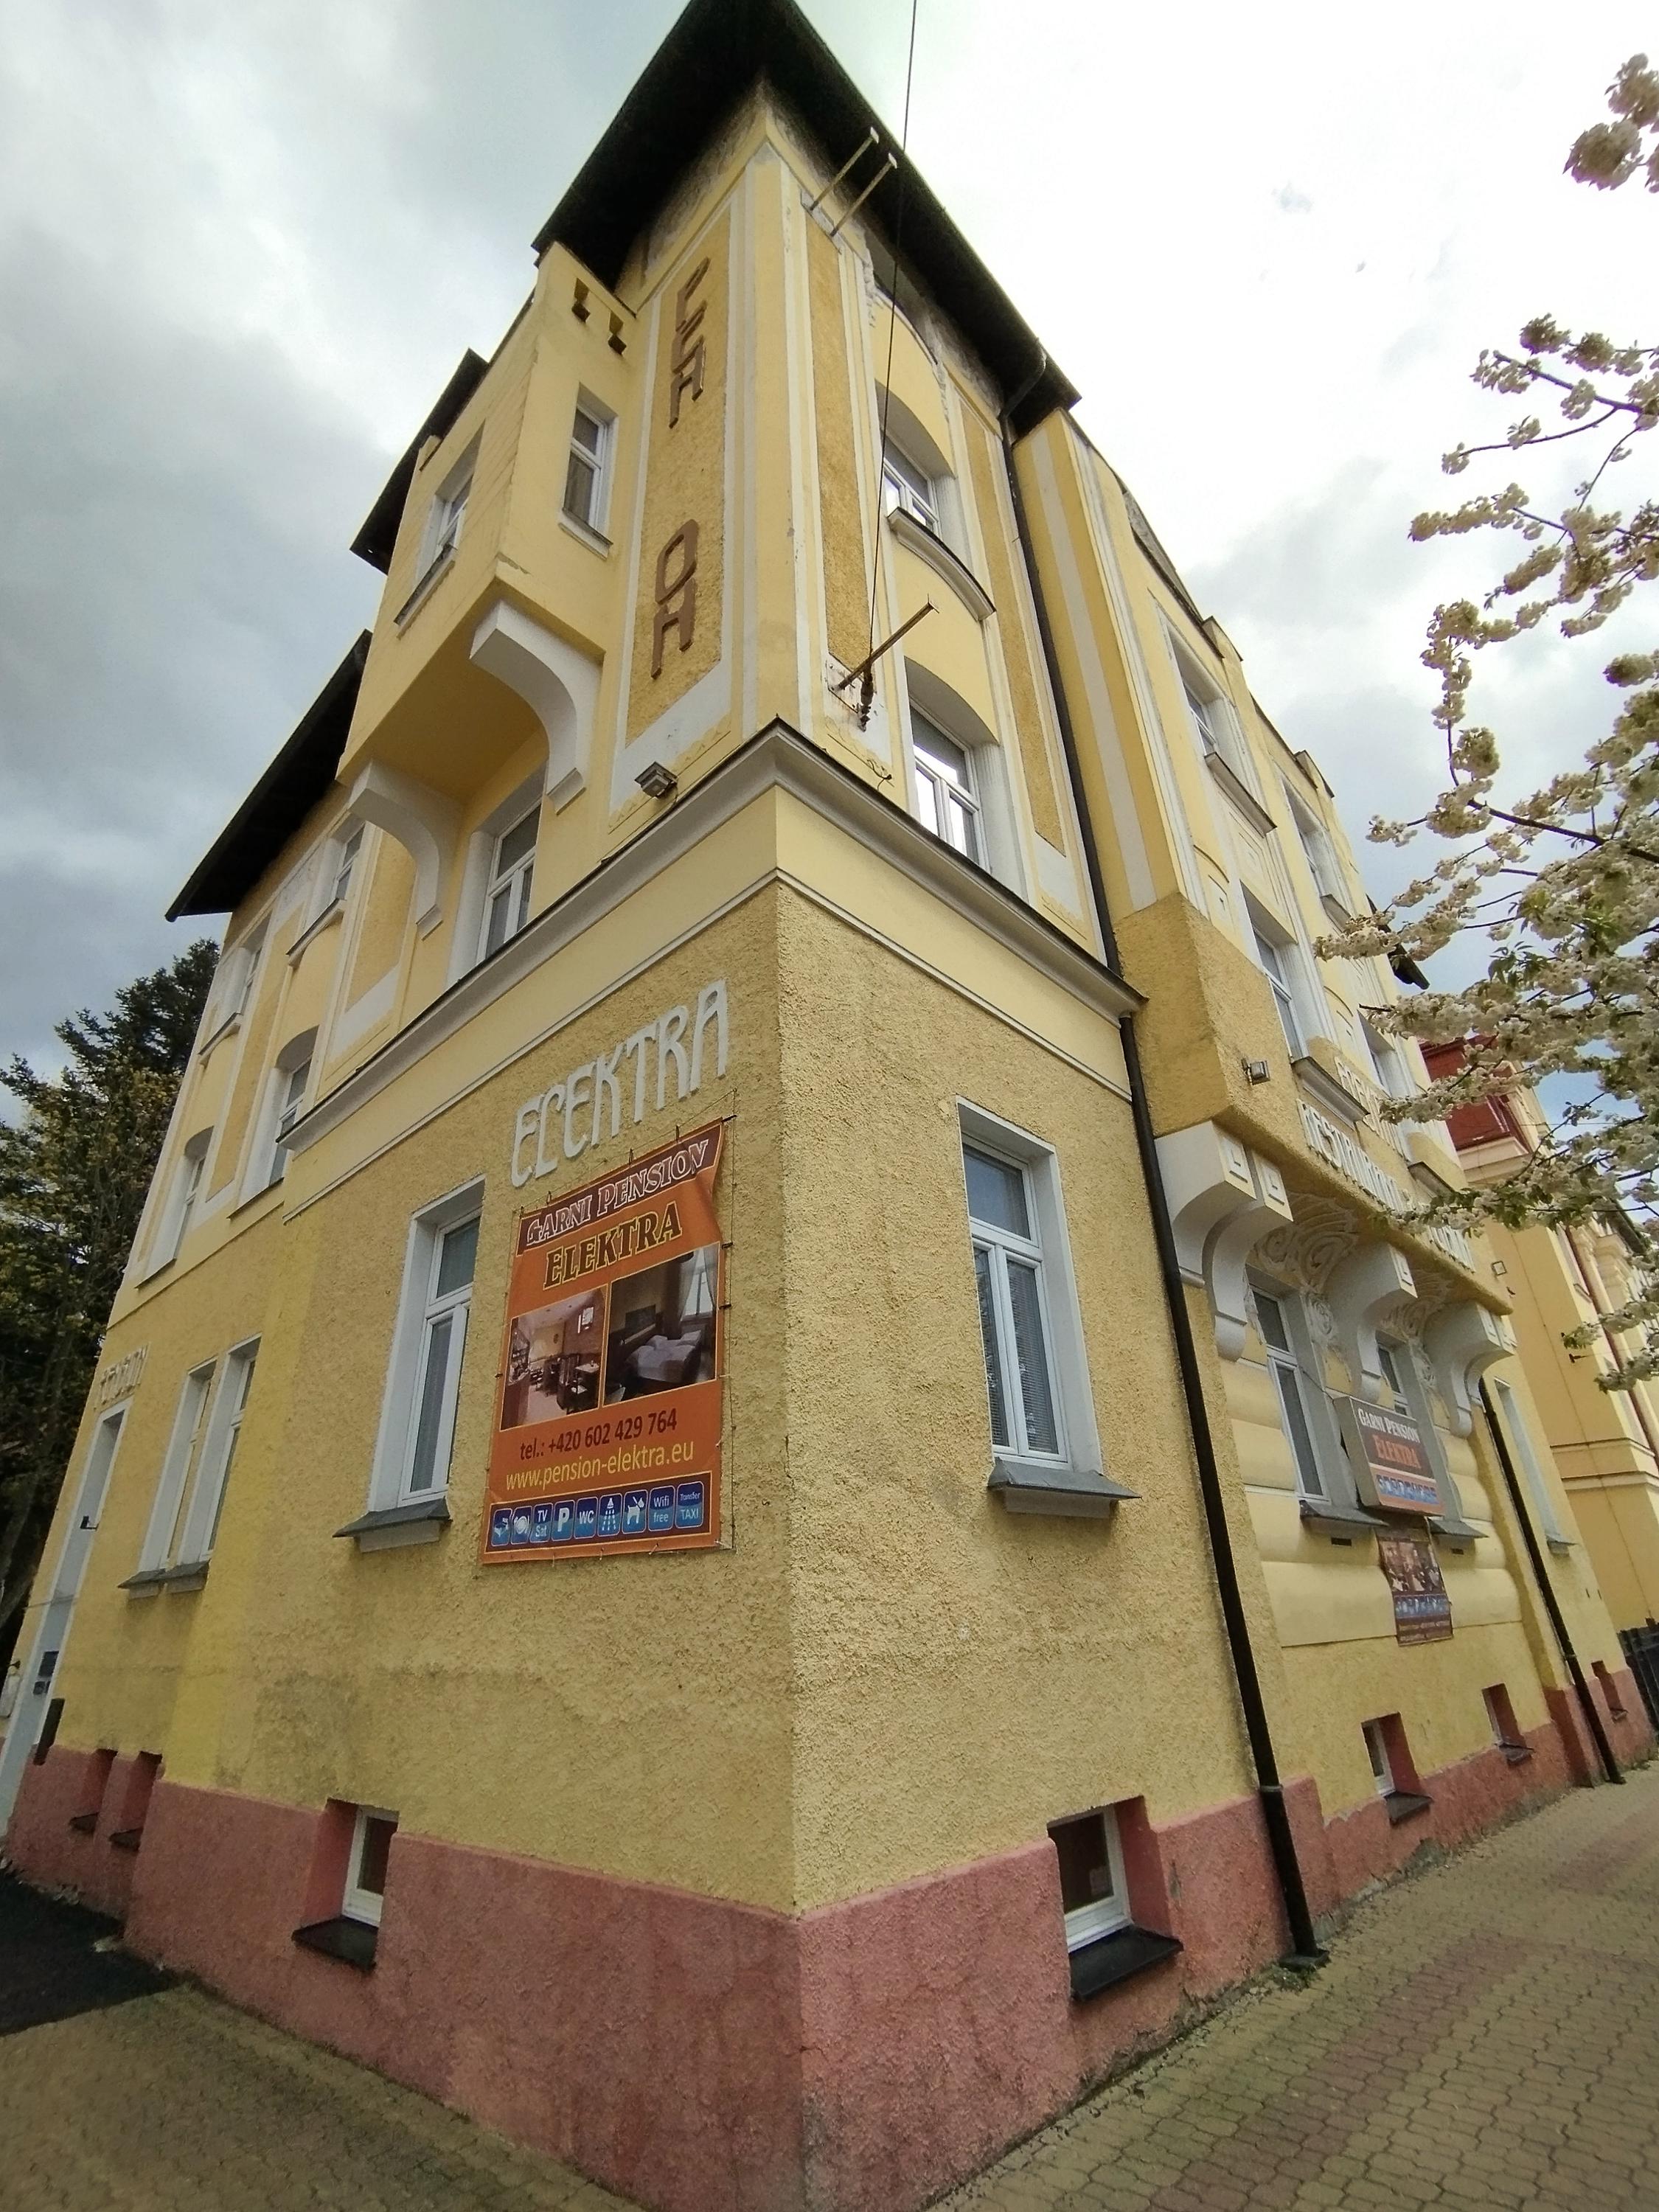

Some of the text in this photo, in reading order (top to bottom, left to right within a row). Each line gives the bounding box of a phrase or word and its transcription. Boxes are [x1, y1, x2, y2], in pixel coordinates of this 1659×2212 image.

[511, 978, 728, 1187] ELEKTRA
[526, 1138, 709, 1246] GARNI PENSION
[543, 1200, 683, 1290] ELEKTRA
[520, 1408, 678, 1461] tel.: +420 602 429 764
[1383, 1416, 1421, 1443] PENSION
[506, 1440, 695, 1491] www.pension-elektra.eu
[653, 1495, 670, 1509] Wifi
[680, 1491, 701, 1502] Transfer
[538, 1509, 548, 1522] TV
[579, 1509, 594, 1524] WC
[653, 1512, 669, 1524] free
[681, 1508, 700, 1521] TAXI
[535, 1525, 547, 1538] Sat
